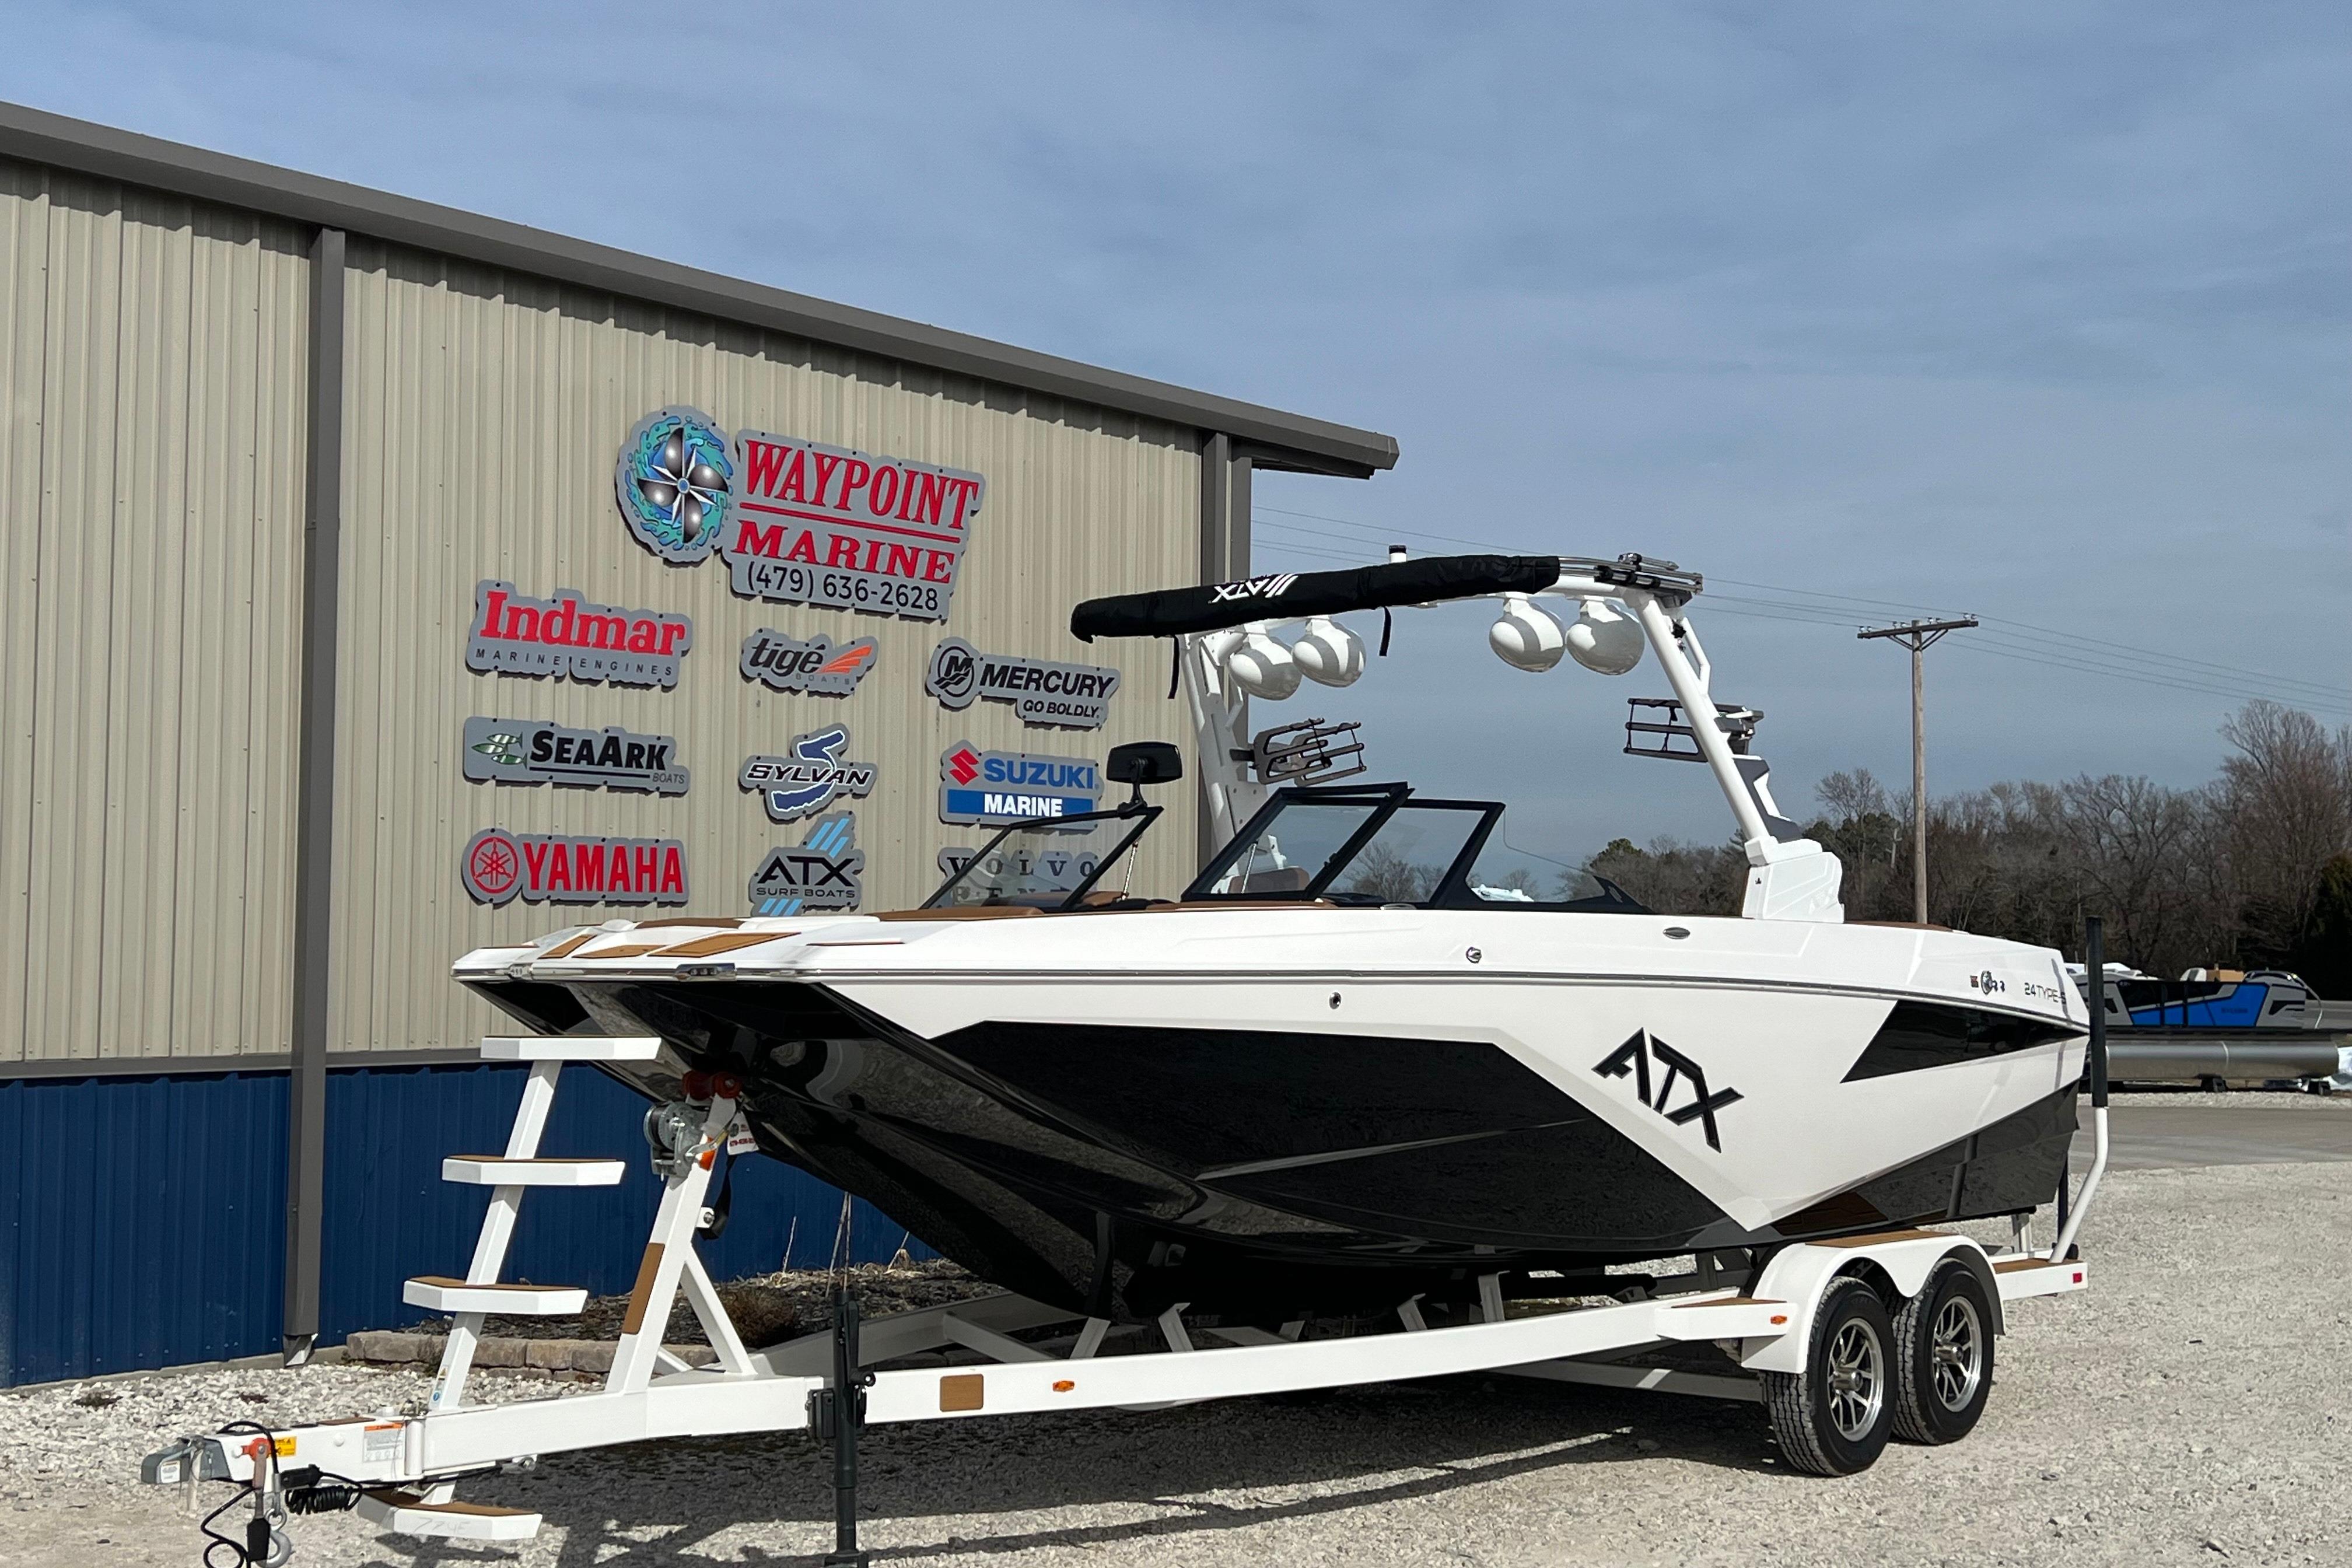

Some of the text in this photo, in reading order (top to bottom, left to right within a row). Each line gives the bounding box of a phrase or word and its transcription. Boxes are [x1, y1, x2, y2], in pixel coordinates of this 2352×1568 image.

[746, 440, 978, 529] WAYPOINT
[732, 520, 955, 583] MARINE
[748, 561, 939, 611] (479) 636-2628
[480, 590, 686, 656] Indmar
[475, 648, 672, 676] MARINE ENGINES
[796, 673, 850, 685] BOATS
[979, 663, 1115, 699] MERCURY
[1023, 699, 1044, 713] GO
[652, 772, 685, 784] BOATS
[747, 764, 871, 785] SYLVAN
[984, 758, 1093, 789] SUZUKI
[984, 793, 1063, 817] MARINE
[523, 842, 684, 894] YAMAHA
[758, 856, 855, 887] ATX
[756, 887, 856, 898] SURF BOATS
[1591, 1027, 1745, 1153] ATX
